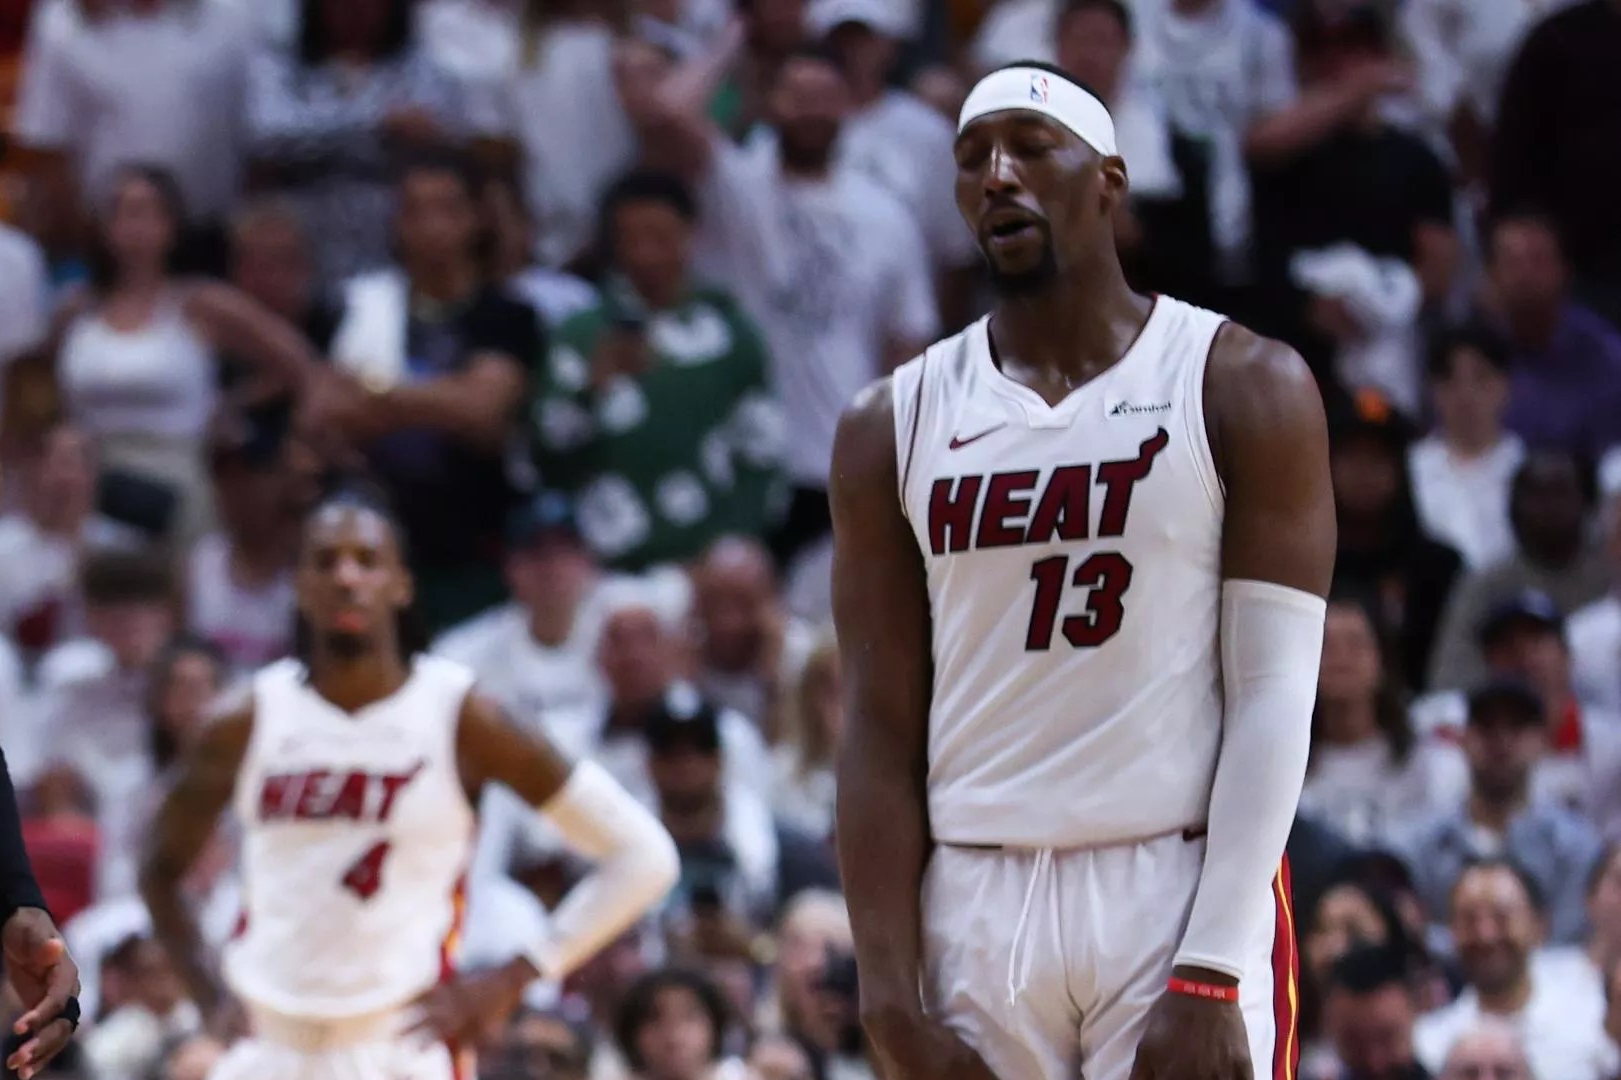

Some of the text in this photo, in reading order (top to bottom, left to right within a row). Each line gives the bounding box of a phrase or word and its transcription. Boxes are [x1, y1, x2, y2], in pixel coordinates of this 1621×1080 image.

[928, 425, 1169, 556] HEAT
[1025, 551, 1133, 651] 13
[258, 757, 425, 822] HEAT
[340, 838, 395, 902] 4
